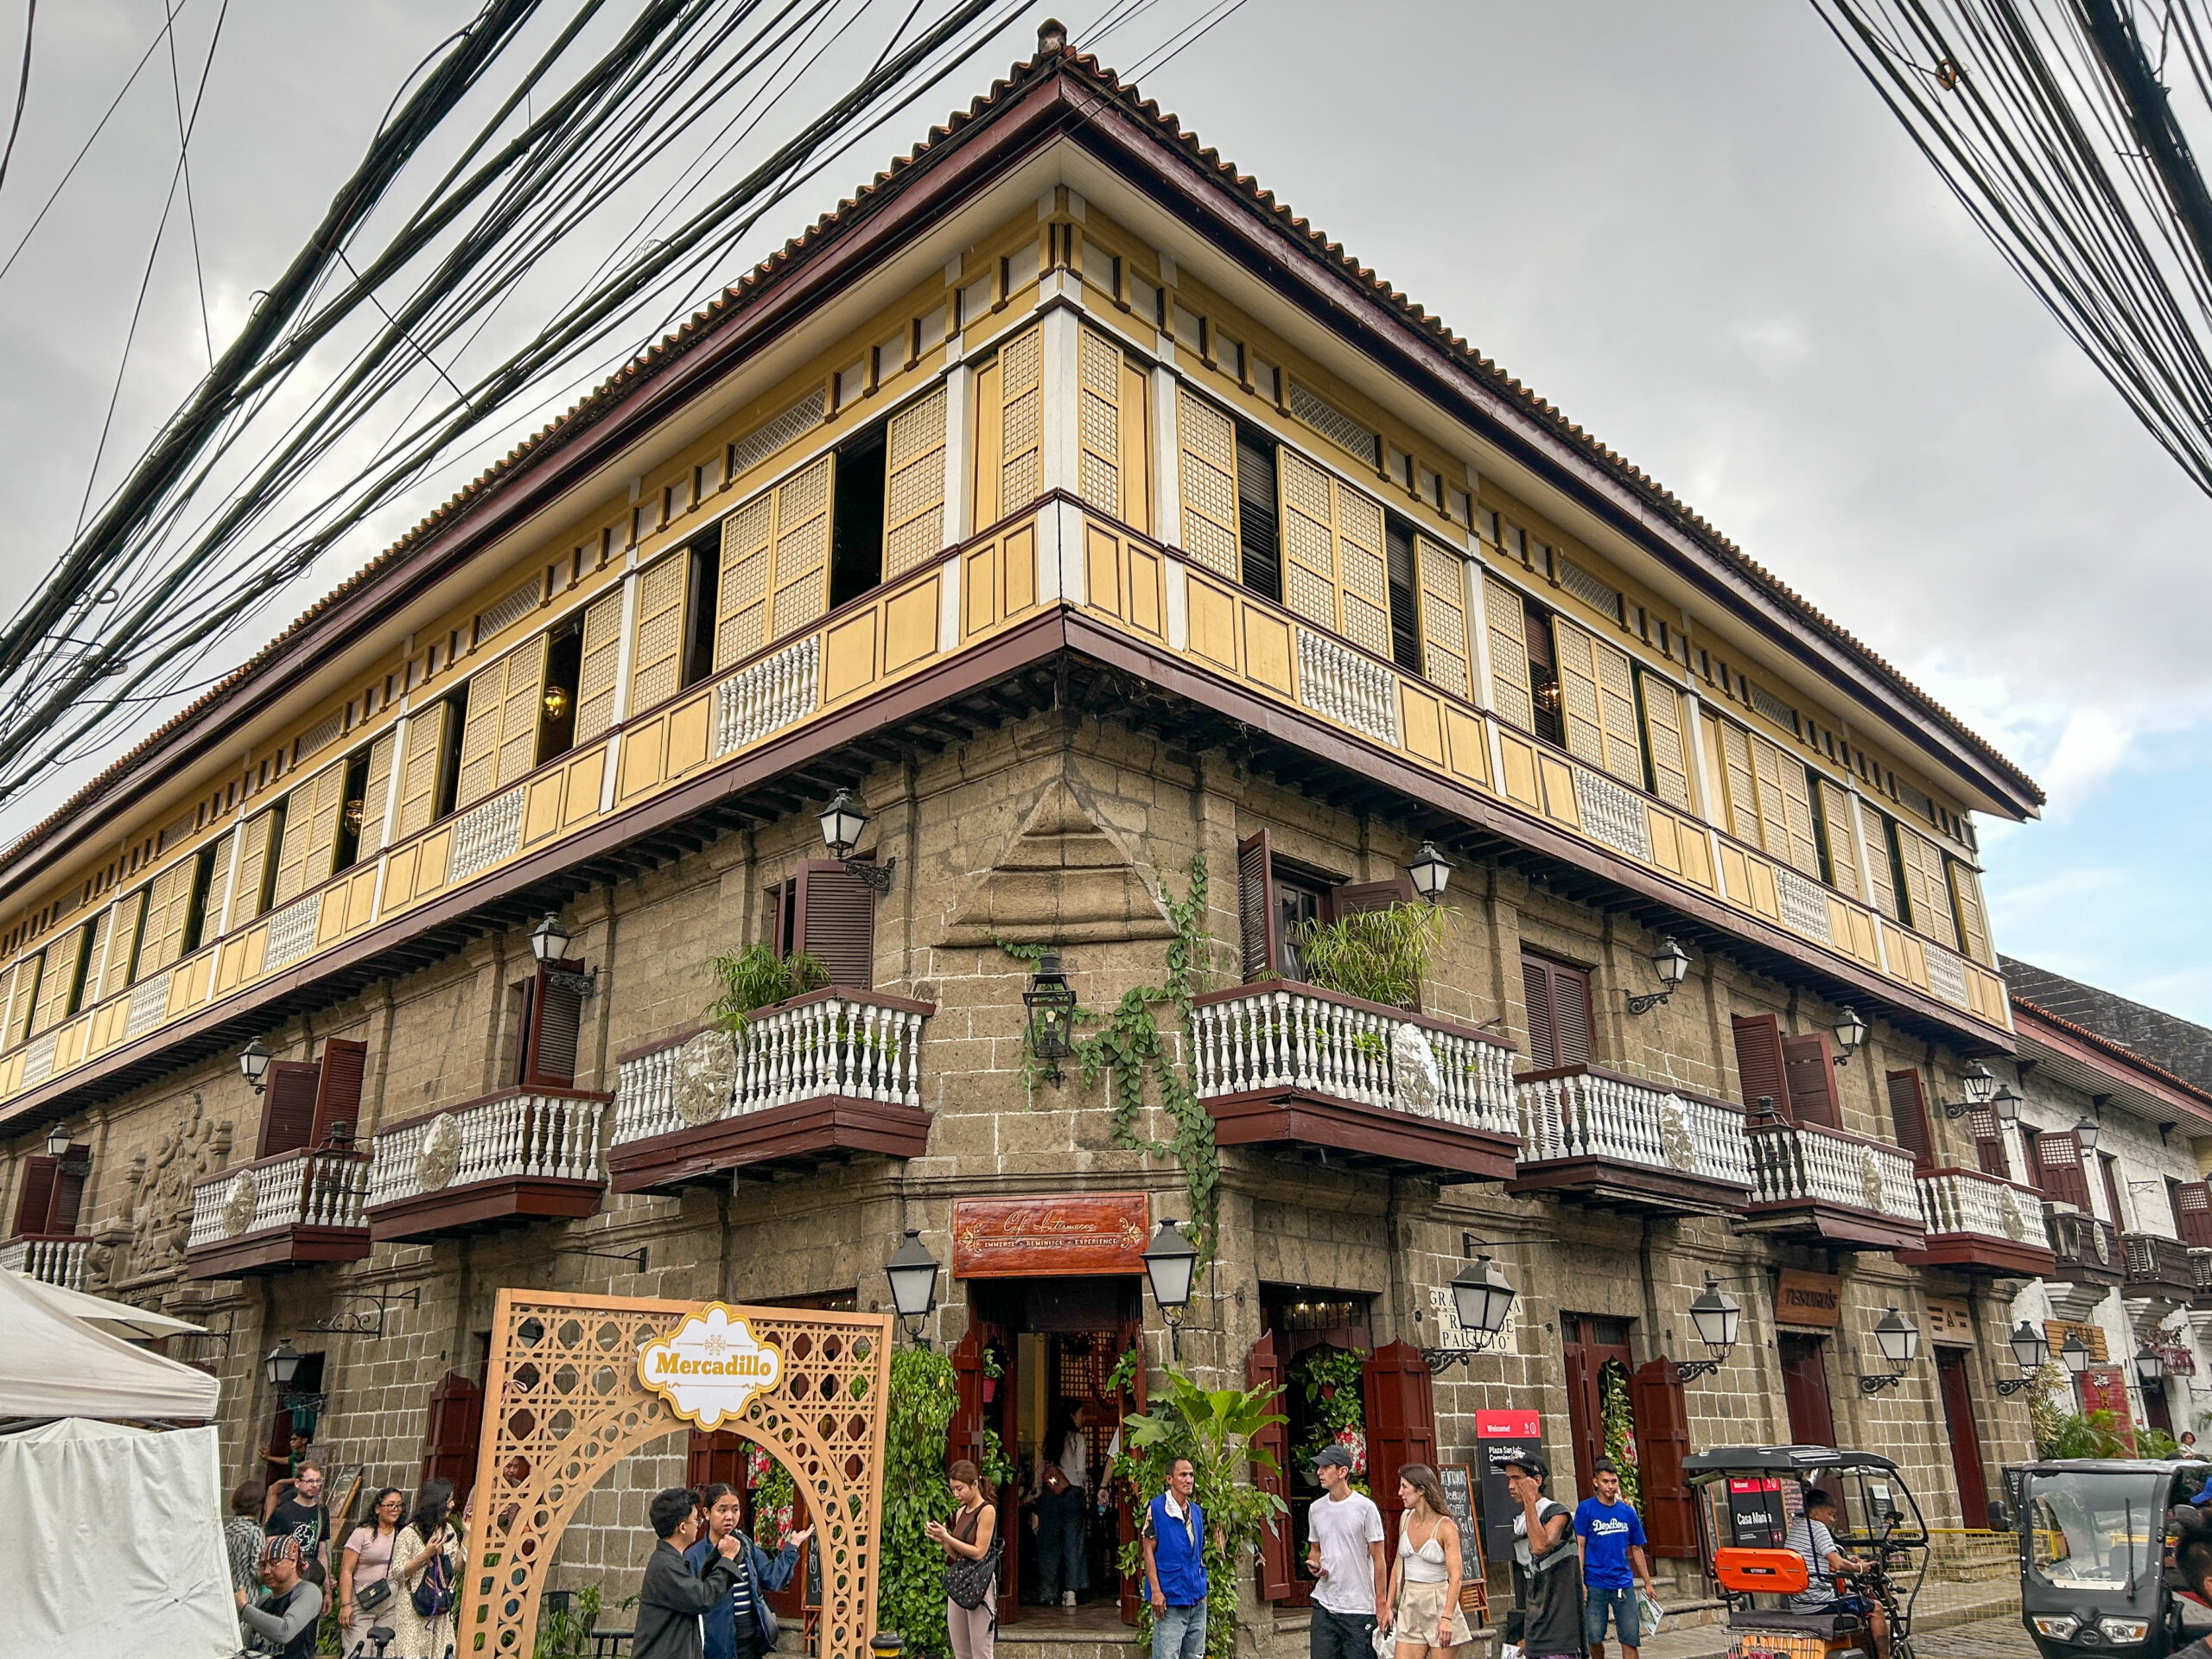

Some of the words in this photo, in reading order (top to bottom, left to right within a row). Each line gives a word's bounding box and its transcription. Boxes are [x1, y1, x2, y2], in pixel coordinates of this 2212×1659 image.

[1429, 1290, 1457, 1306] GRA
[655, 1352, 772, 1376] Mercadillo
[1486, 1424, 1510, 1433] Welcome!
[1737, 1512, 1753, 1526] Casa
[1752, 1510, 1772, 1524] Mania
